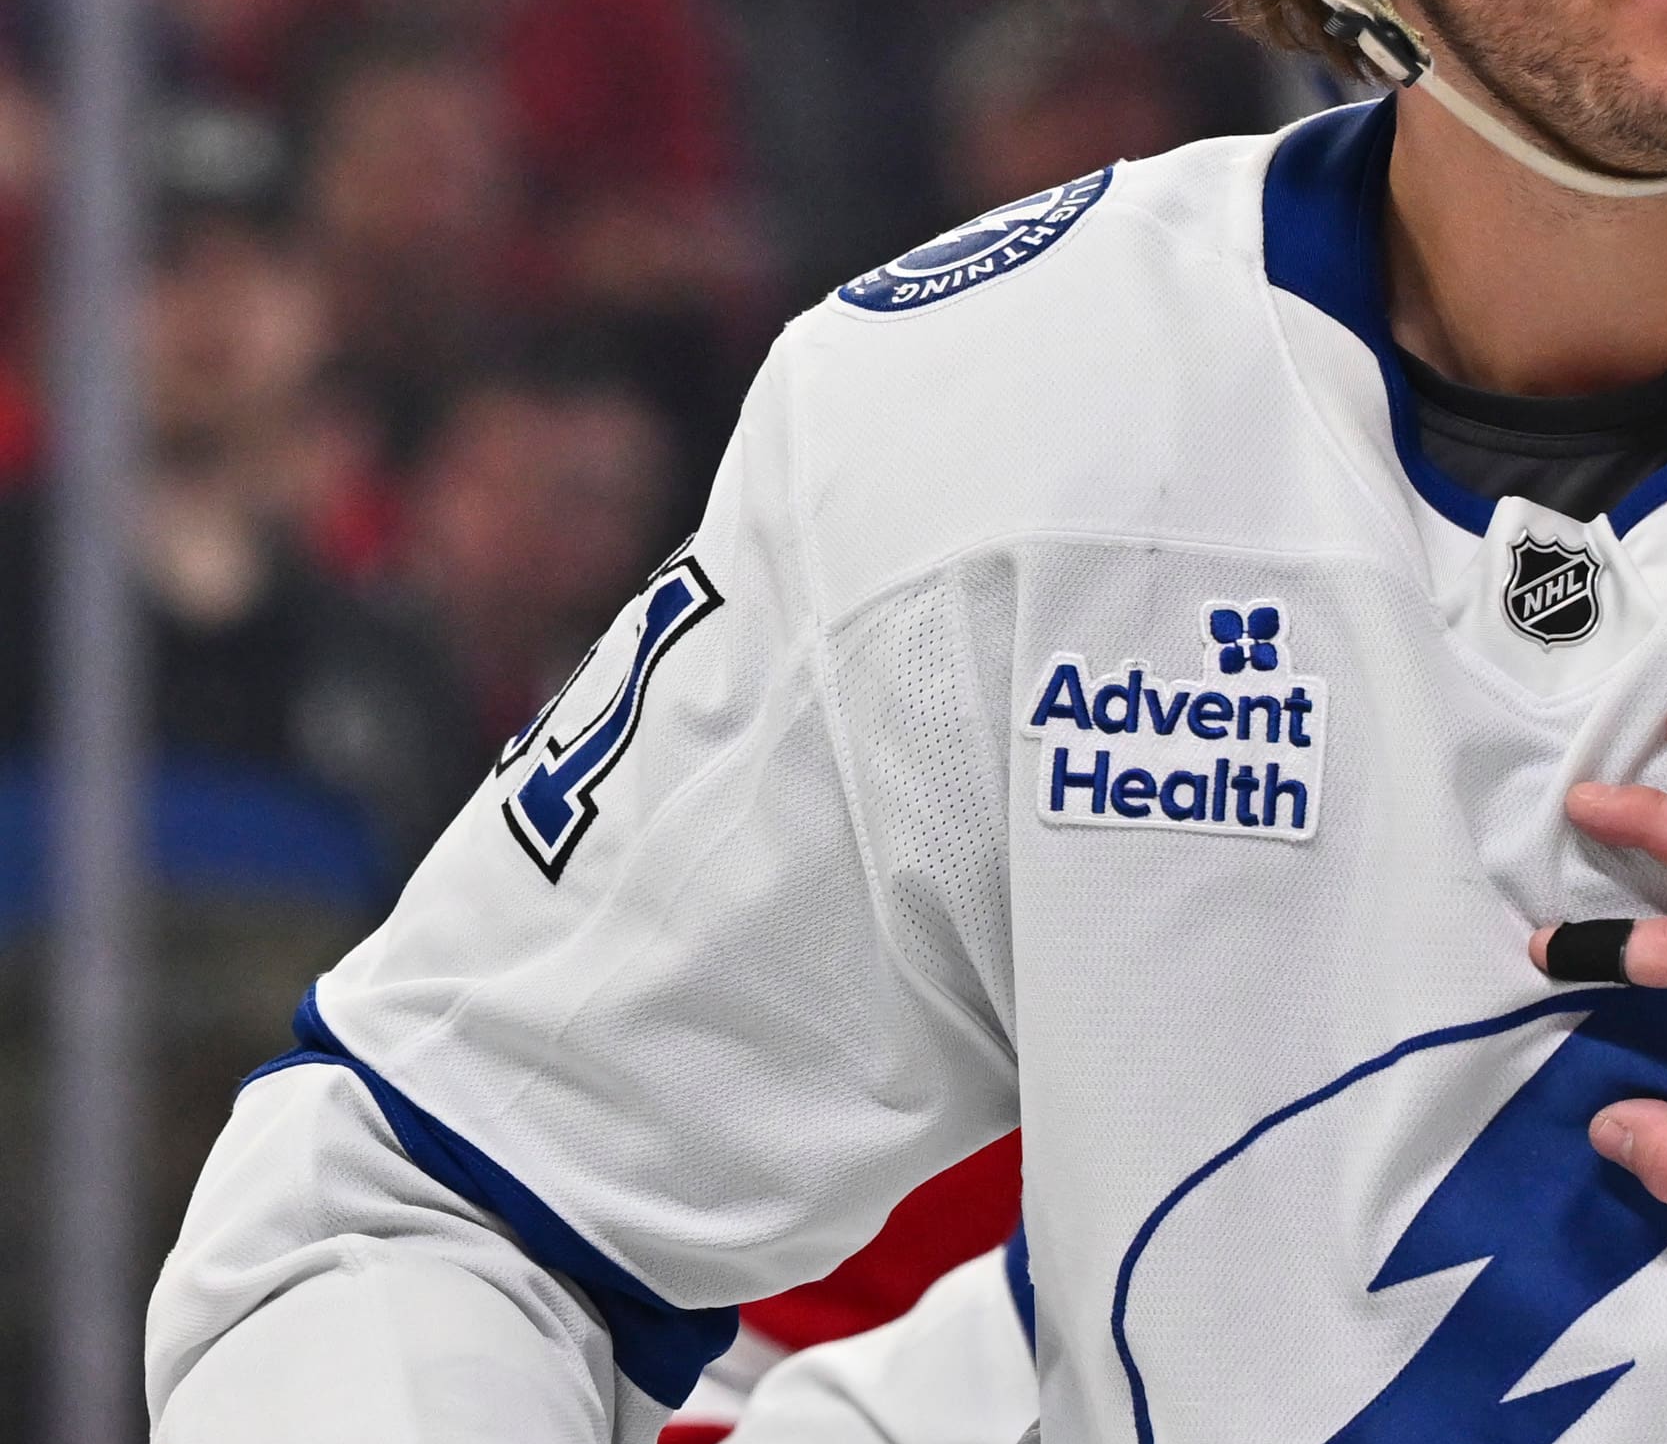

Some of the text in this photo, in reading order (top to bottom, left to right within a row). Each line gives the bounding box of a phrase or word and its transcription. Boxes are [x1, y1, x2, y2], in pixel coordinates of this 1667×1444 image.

[1523, 569, 1583, 618] NHL
[1030, 664, 1312, 747] Advent
[1050, 747, 1307, 829] Health
